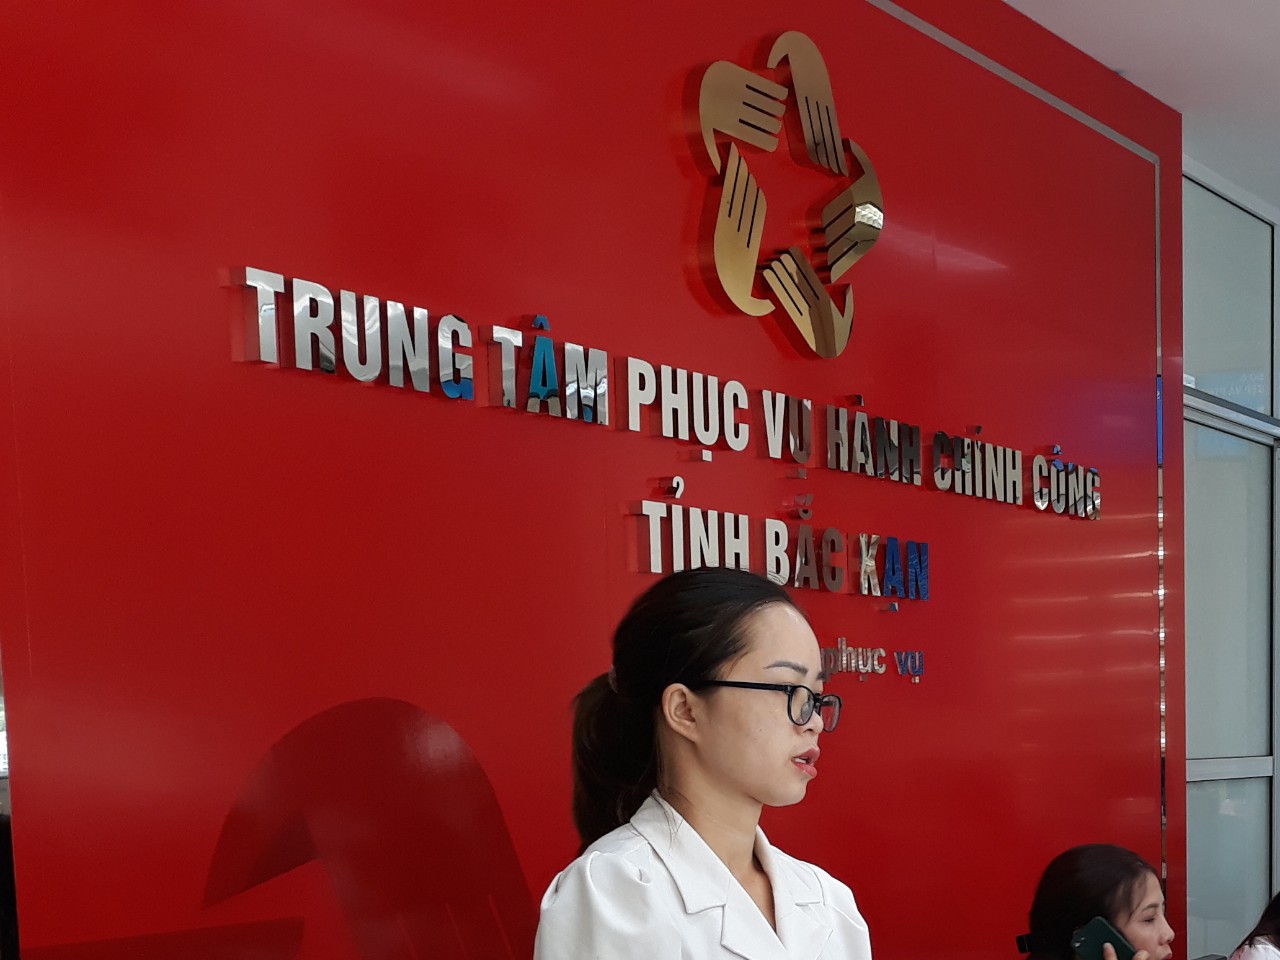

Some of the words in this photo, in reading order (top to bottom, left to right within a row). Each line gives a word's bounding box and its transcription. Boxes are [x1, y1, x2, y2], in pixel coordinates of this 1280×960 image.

[245, 266, 474, 400] TRUNG
[492, 314, 610, 426] TÂM
[627, 356, 750, 462] PHỤC
[762, 389, 812, 480] VỤ
[826, 394, 922, 487] HÀNH
[933, 424, 1024, 506] CHÍNH
[1032, 443, 1102, 521] CÔNG
[641, 475, 750, 574] TỈNH
[765, 492, 844, 593] BẮC
[858, 532, 930, 612] KẠN
[820, 636, 886, 683] phục
[894, 651, 924, 684] vụ
